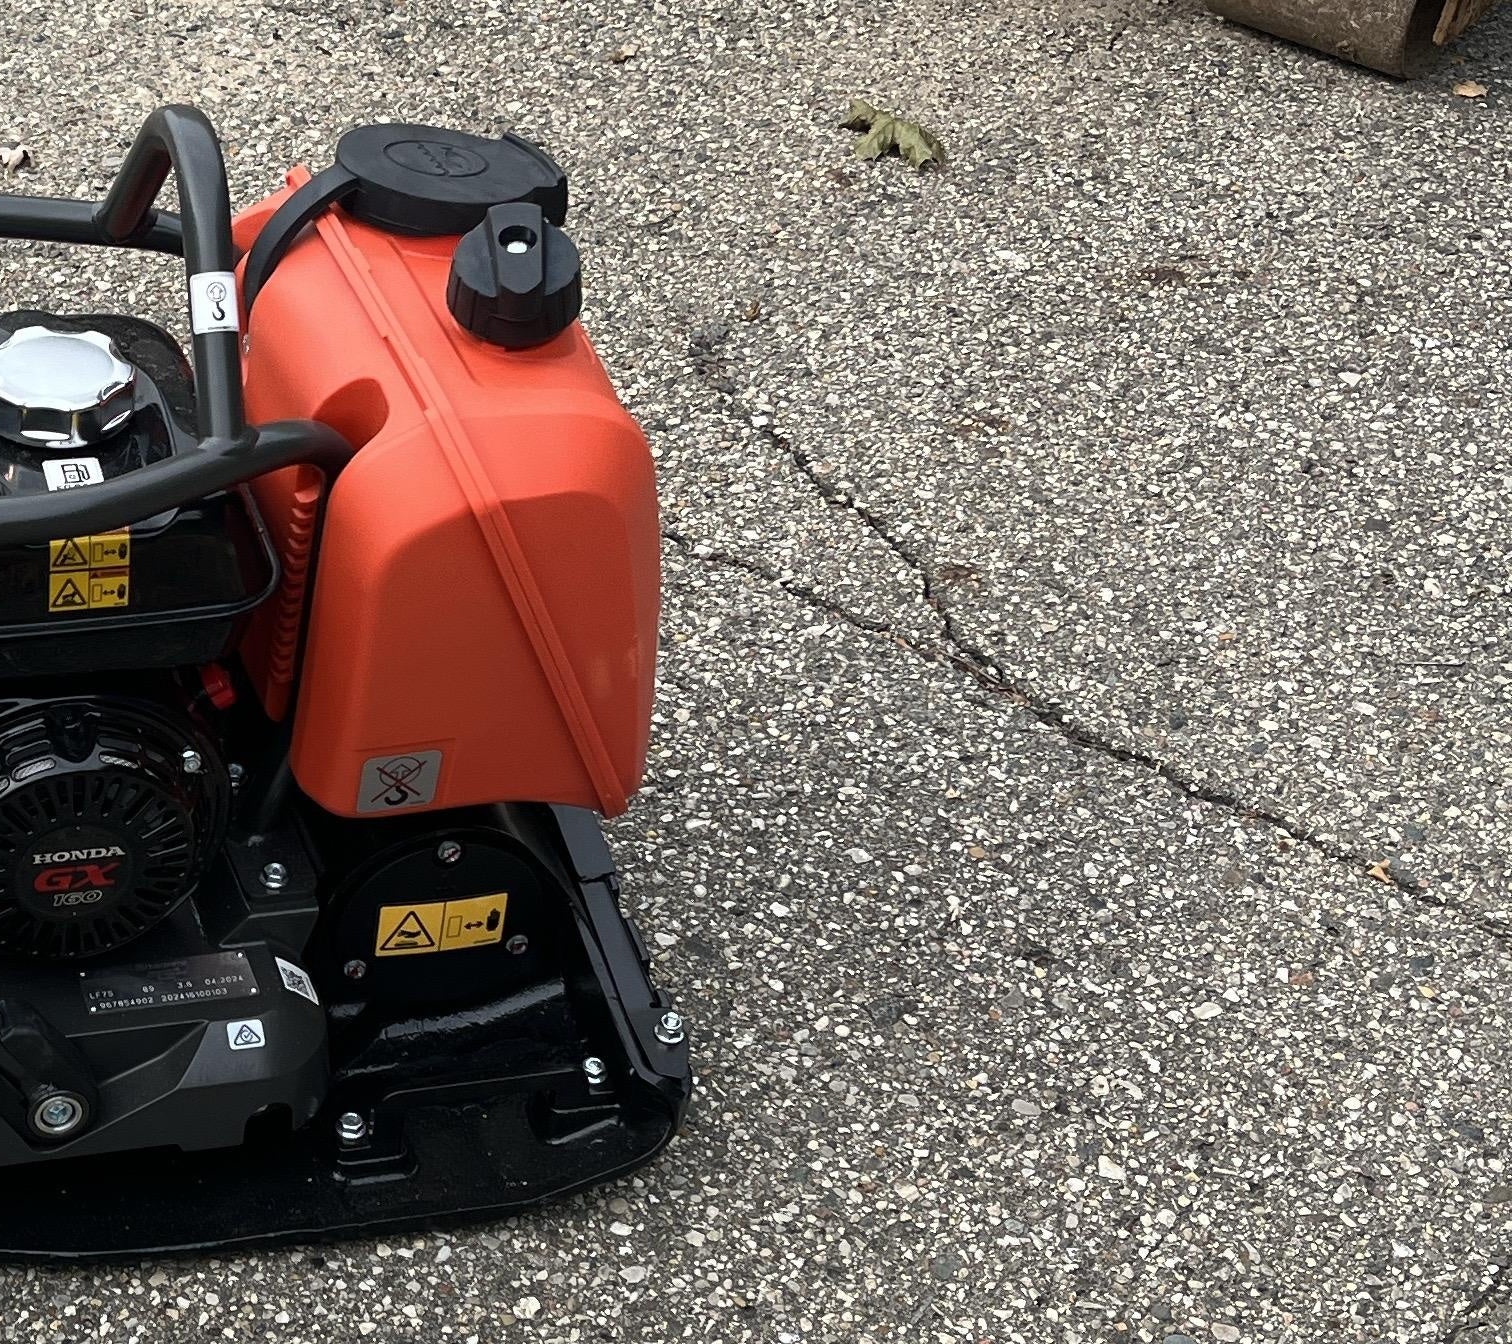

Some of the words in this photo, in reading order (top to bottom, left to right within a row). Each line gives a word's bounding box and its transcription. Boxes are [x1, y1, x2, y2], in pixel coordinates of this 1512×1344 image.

[32, 845, 126, 865] HONDA
[32, 862, 121, 894] GX
[53, 889, 104, 907] 160
